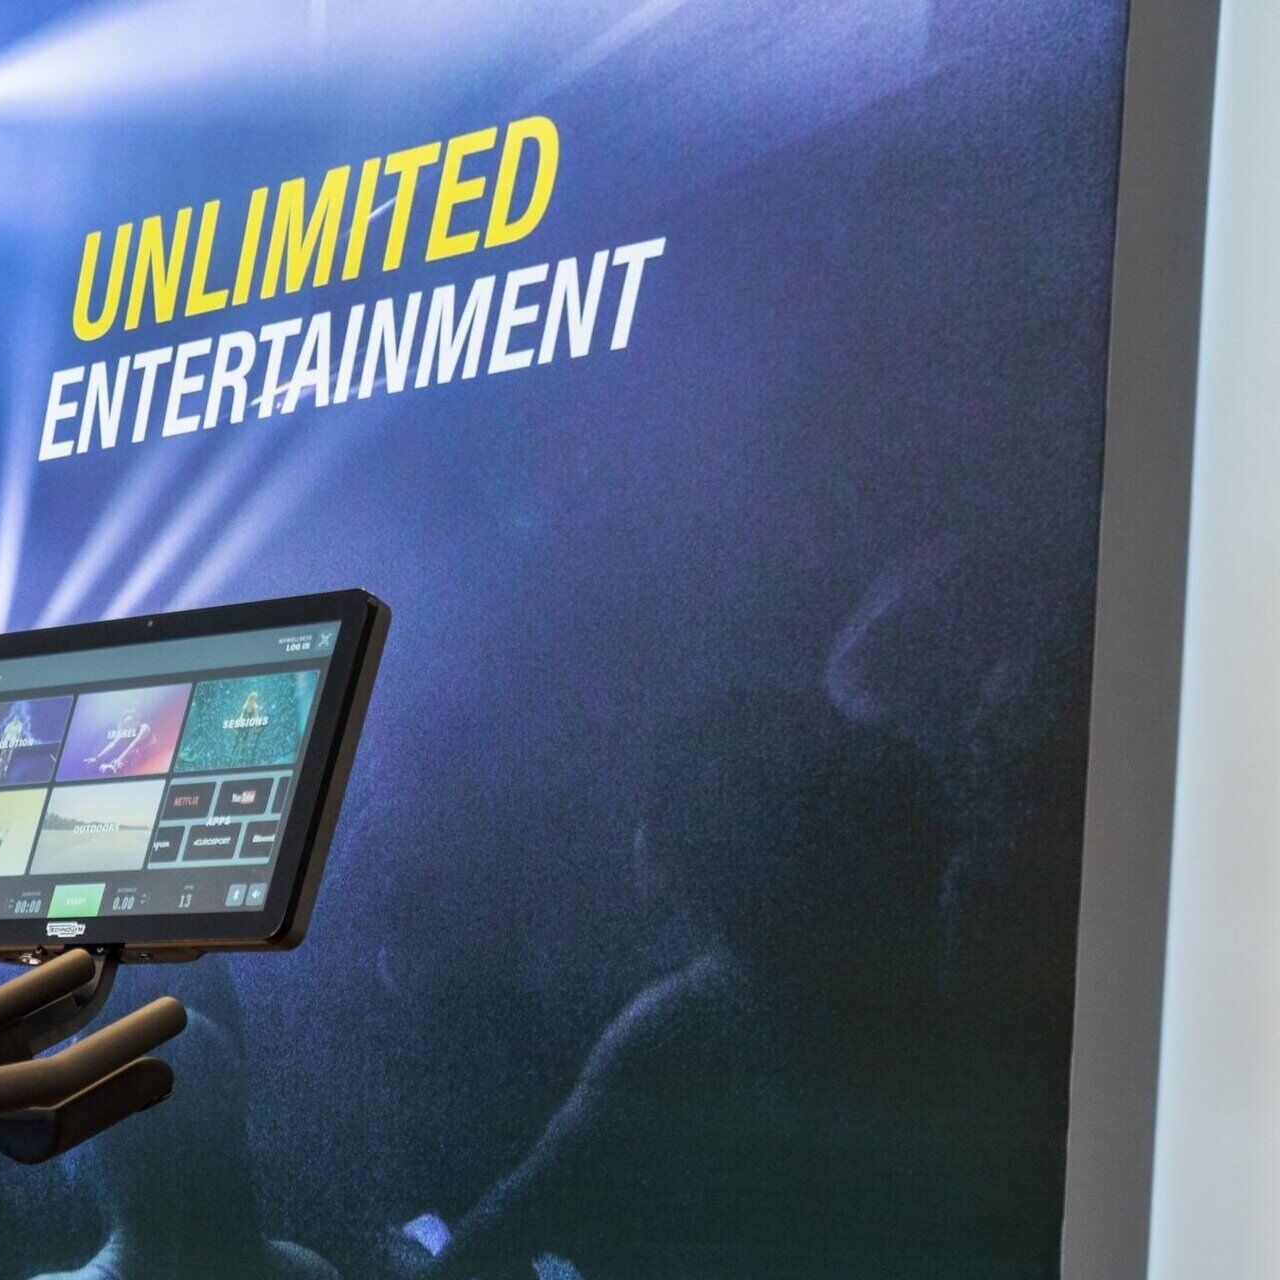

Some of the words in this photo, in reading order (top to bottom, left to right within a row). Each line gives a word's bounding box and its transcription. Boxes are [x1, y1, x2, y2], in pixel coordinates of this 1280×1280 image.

[73, 116, 559, 341] UNLIMITED
[38, 237, 666, 461] ENTERTAINMENT
[286, 643, 300, 652] LOG
[301, 641, 311, 650] IN
[222, 716, 269, 729] SESSIONS
[173, 796, 200, 807] NETFLIX
[73, 823, 120, 834] OUTDOORS
[206, 816, 231, 827] APPS
[14, 899, 42, 914] 00:00
[112, 896, 135, 911] 0.00
[178, 893, 192, 908] 13
